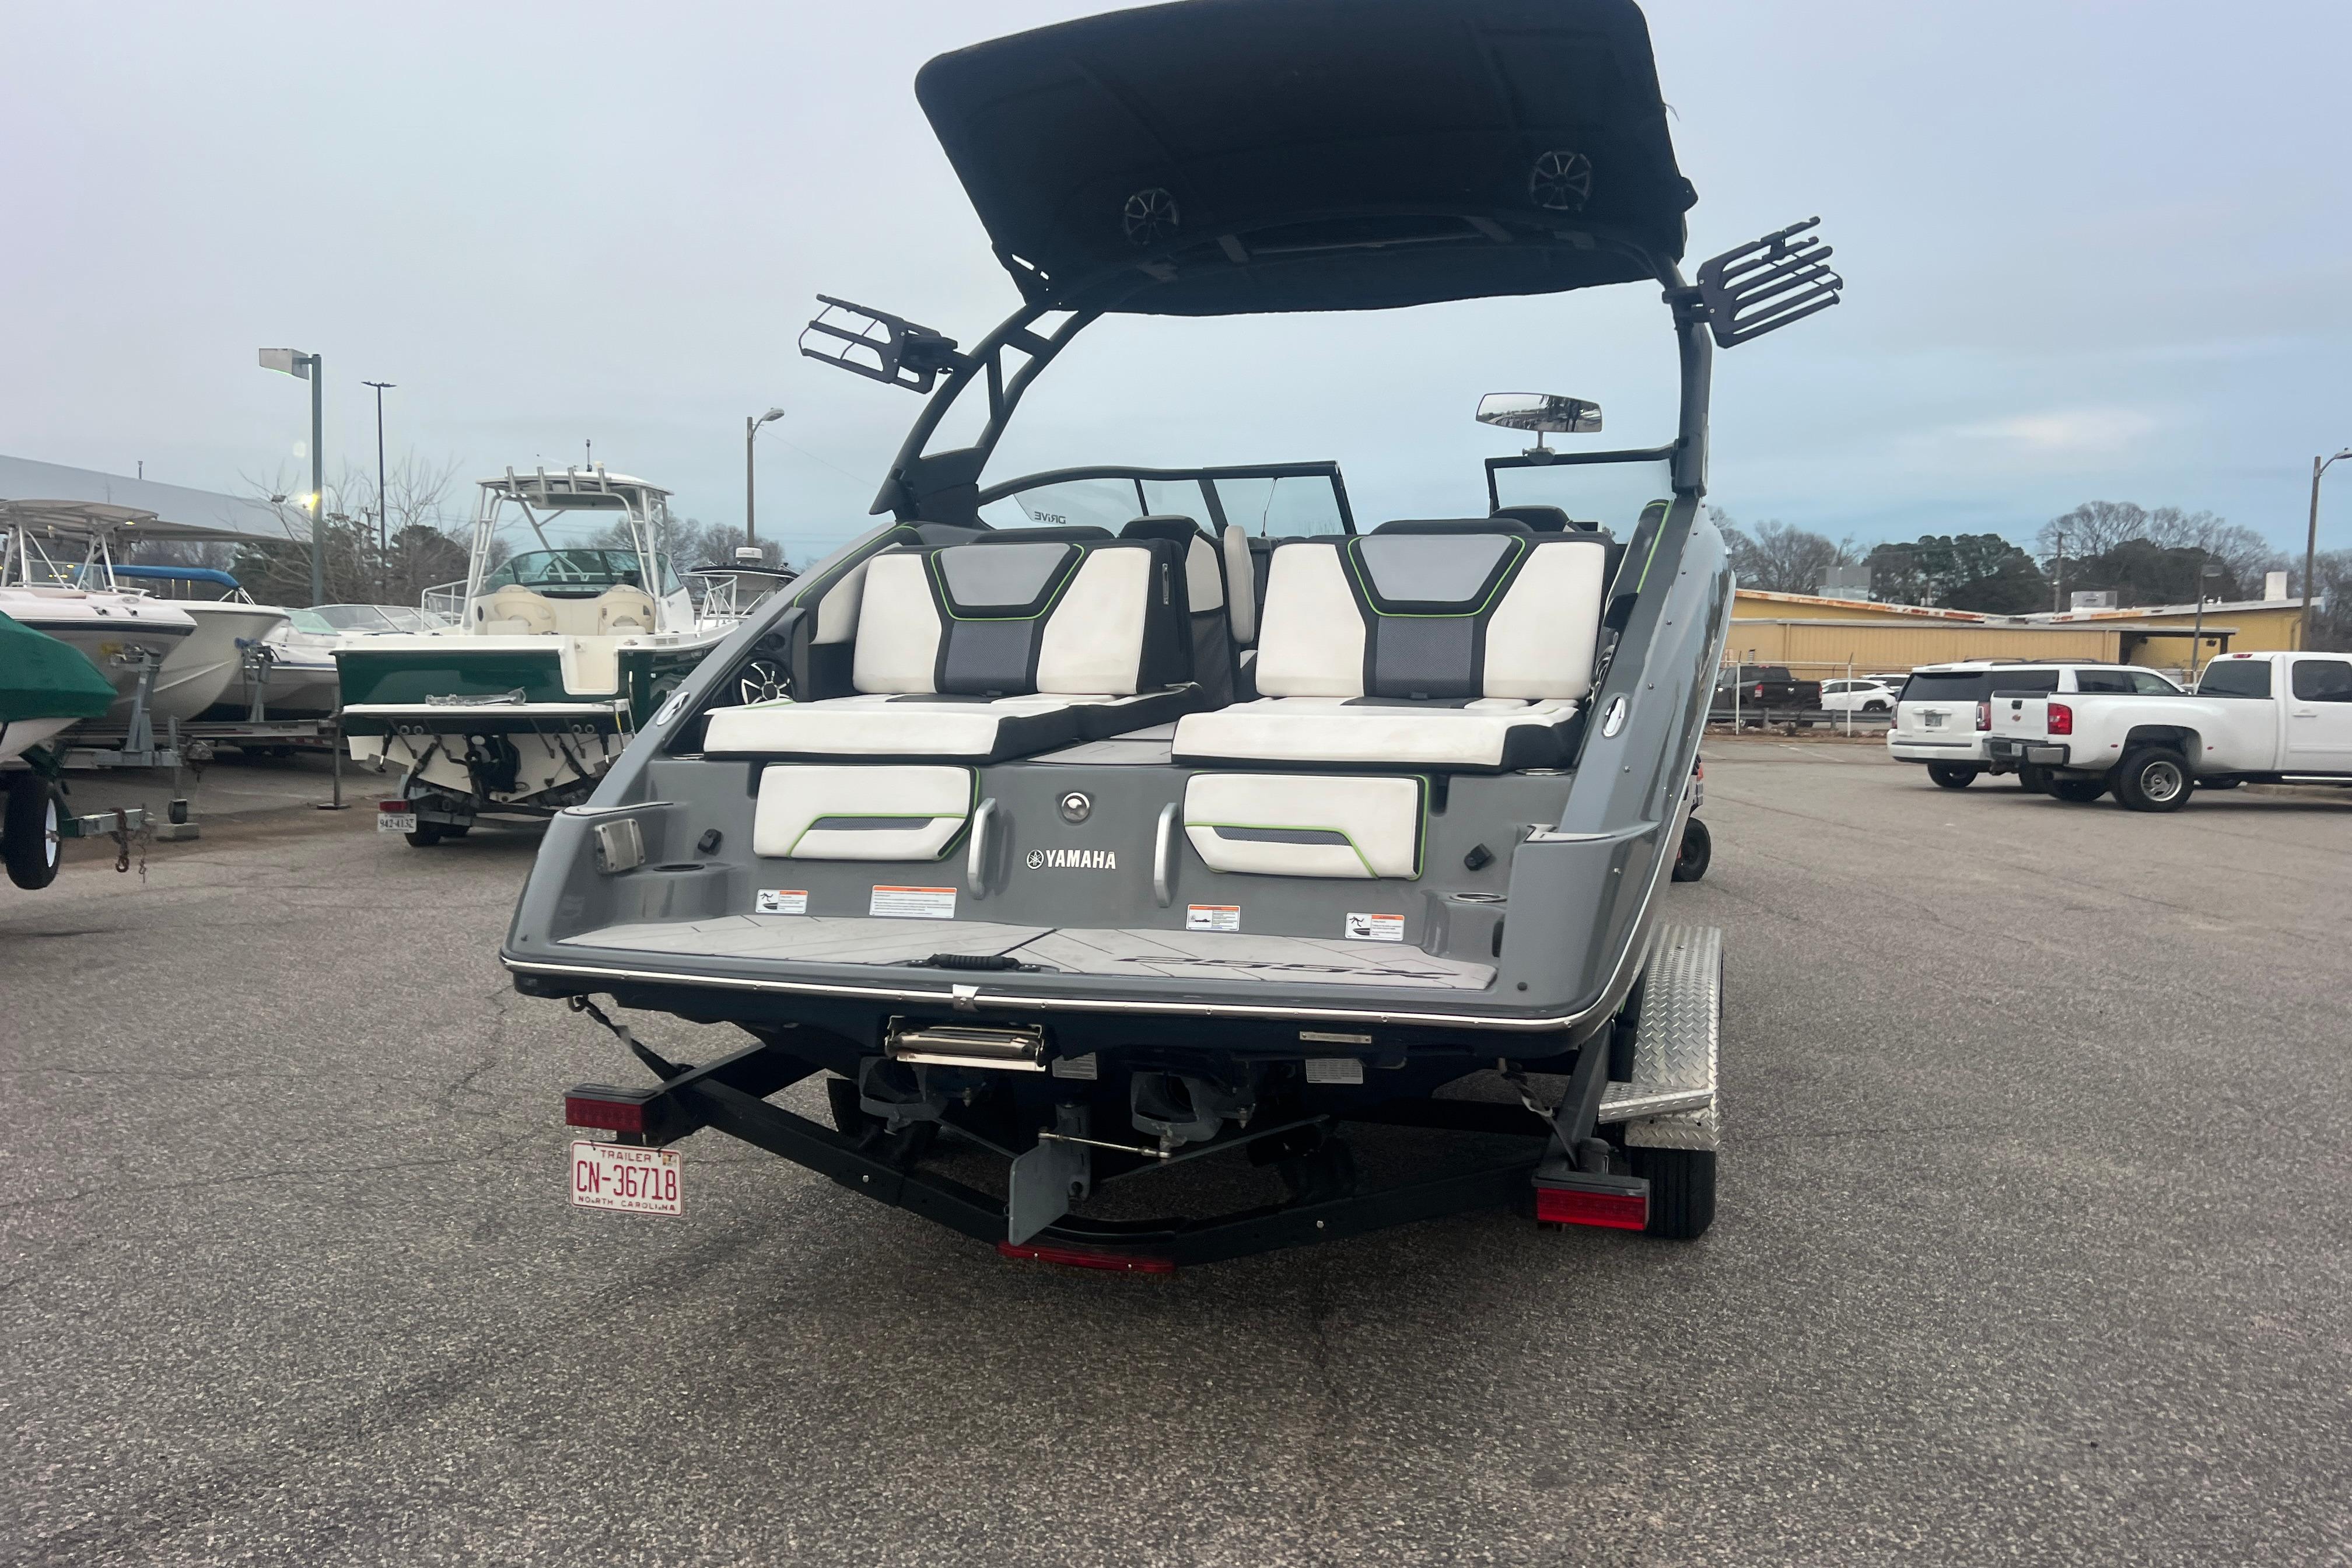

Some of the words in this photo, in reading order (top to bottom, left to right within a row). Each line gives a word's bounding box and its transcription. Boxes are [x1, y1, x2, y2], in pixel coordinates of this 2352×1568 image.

[1046, 849, 1116, 870] YAMAHA
[601, 1149, 652, 1162] TRAILER
[577, 1160, 677, 1201] CN-36718
[578, 1195, 613, 1205] NORTH
[621, 1200, 676, 1211] CAROLINA
